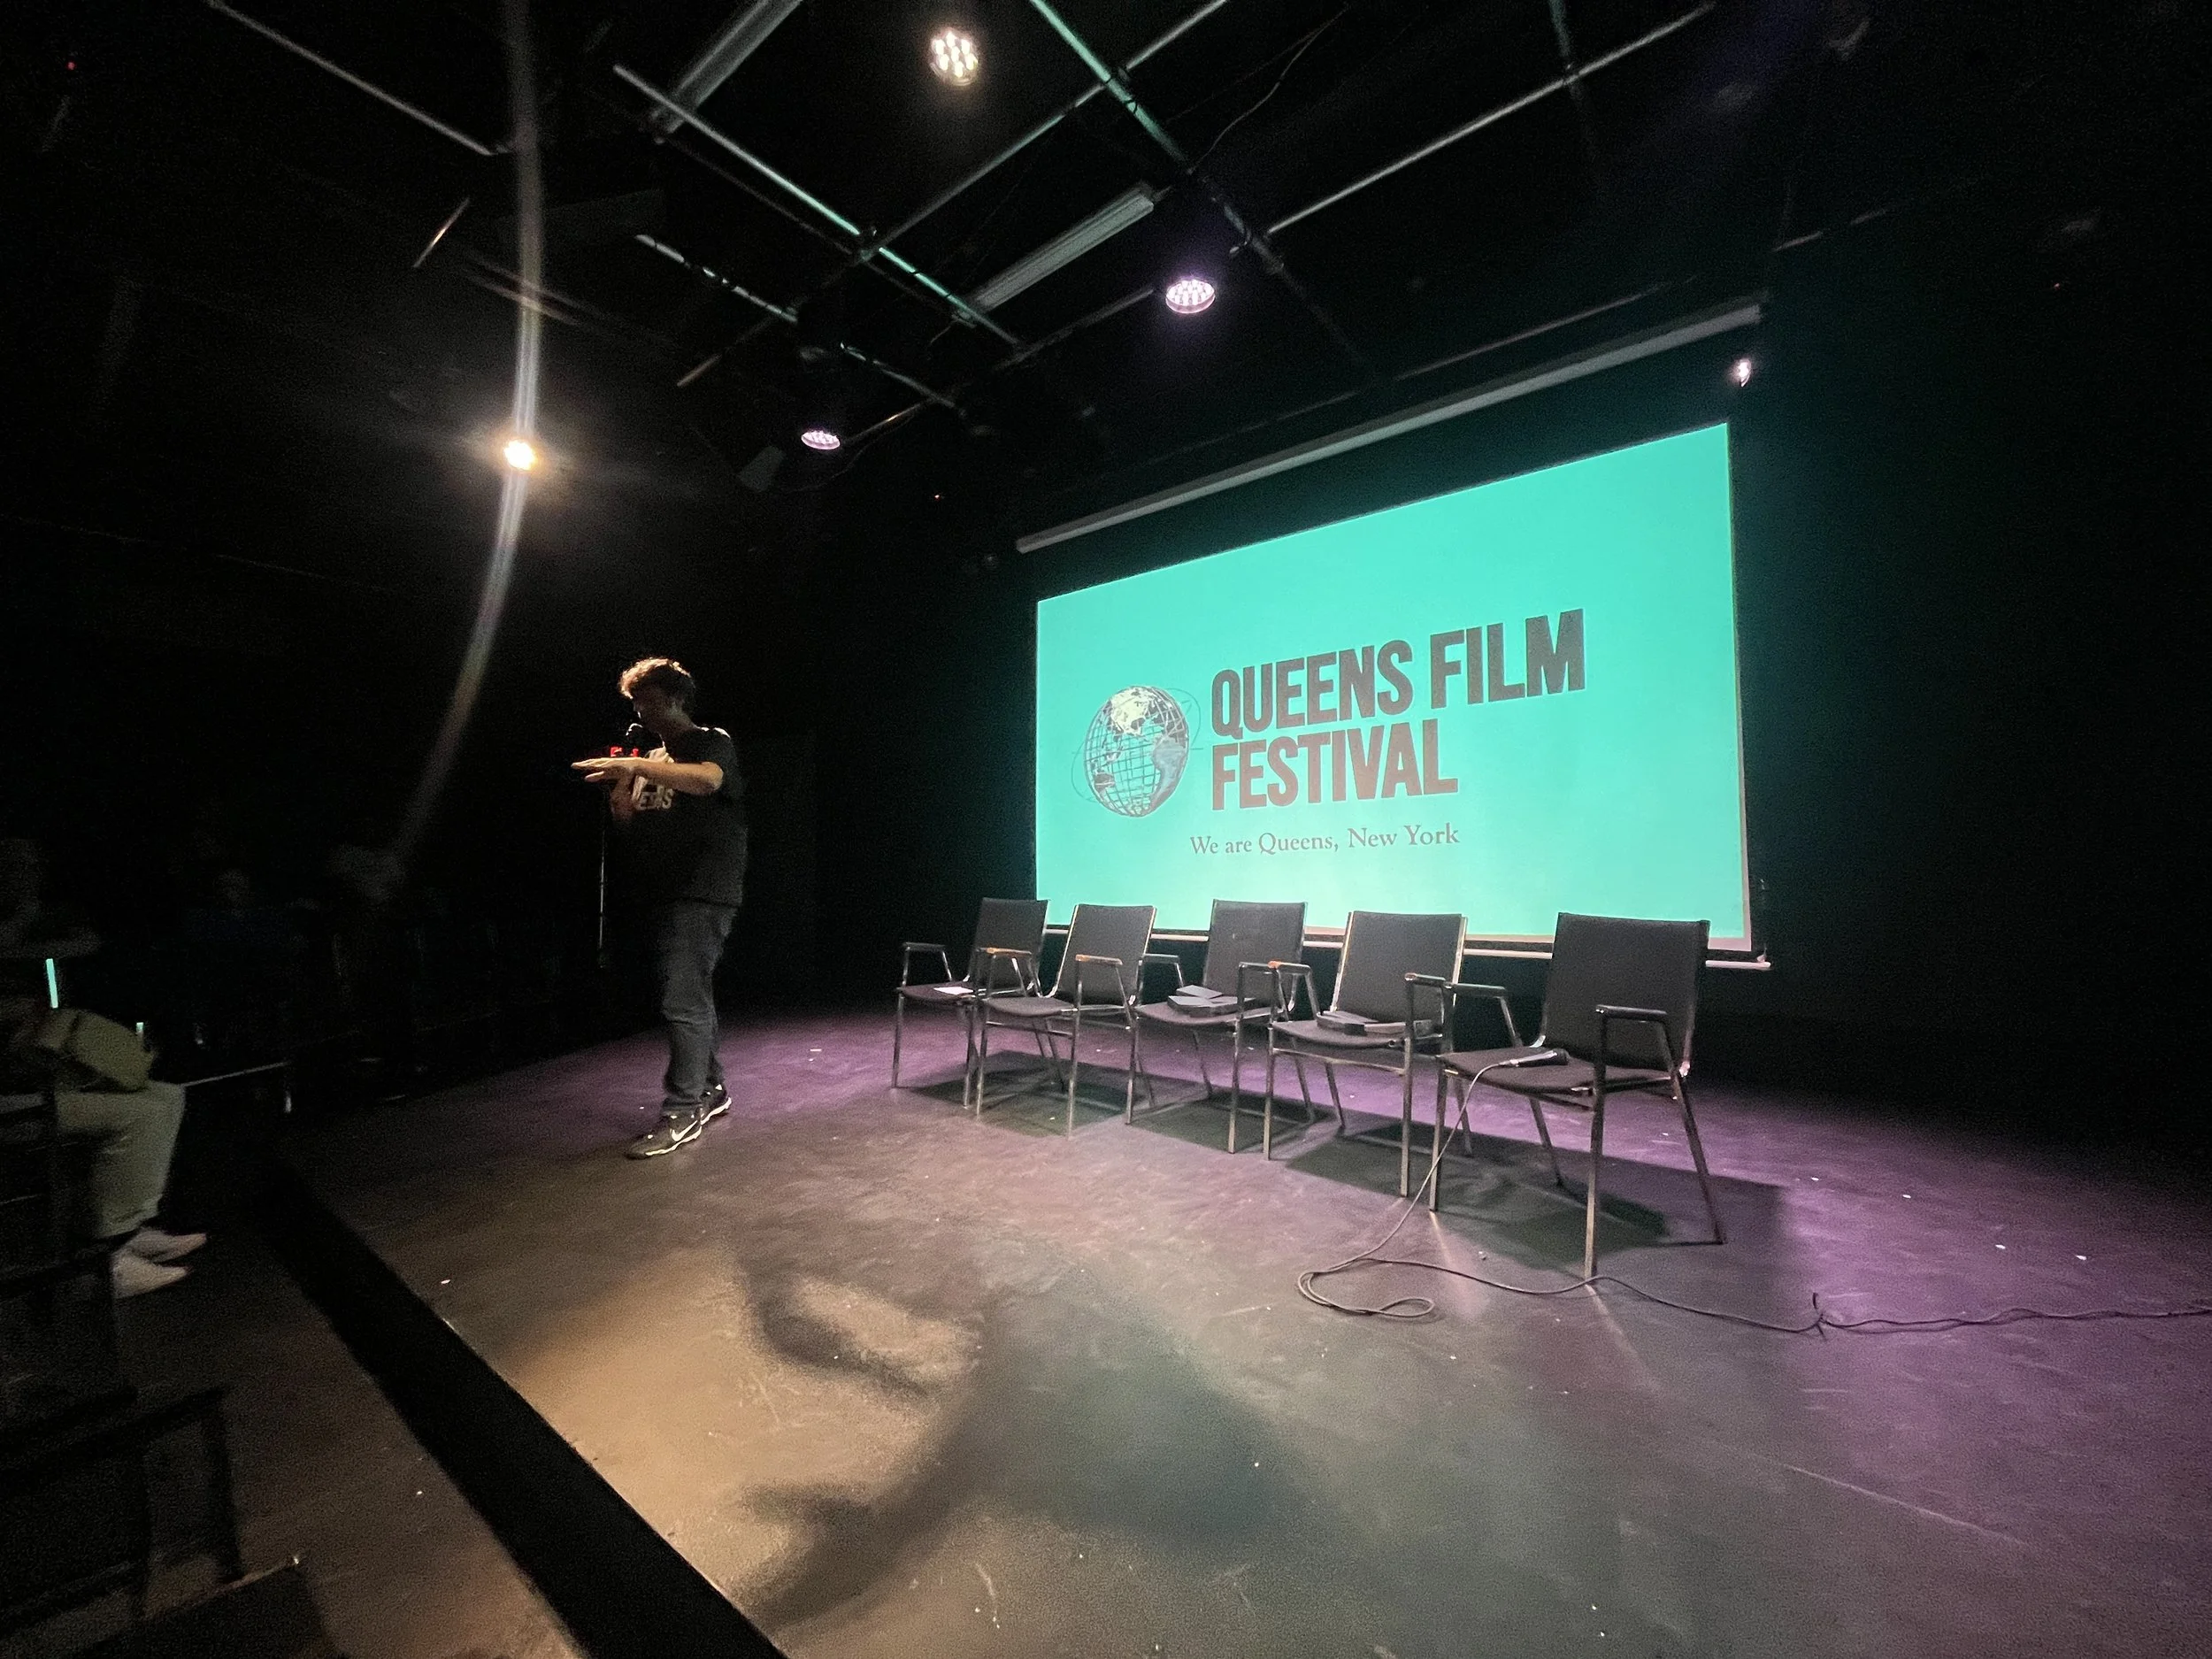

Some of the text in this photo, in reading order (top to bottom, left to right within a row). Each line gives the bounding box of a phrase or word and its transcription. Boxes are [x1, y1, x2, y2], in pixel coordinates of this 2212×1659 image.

[1211, 608, 1586, 741] QUEENS FILM
[1211, 718, 1458, 811] FESTIVAL
[1190, 822, 1461, 856] We are Queens, New York
